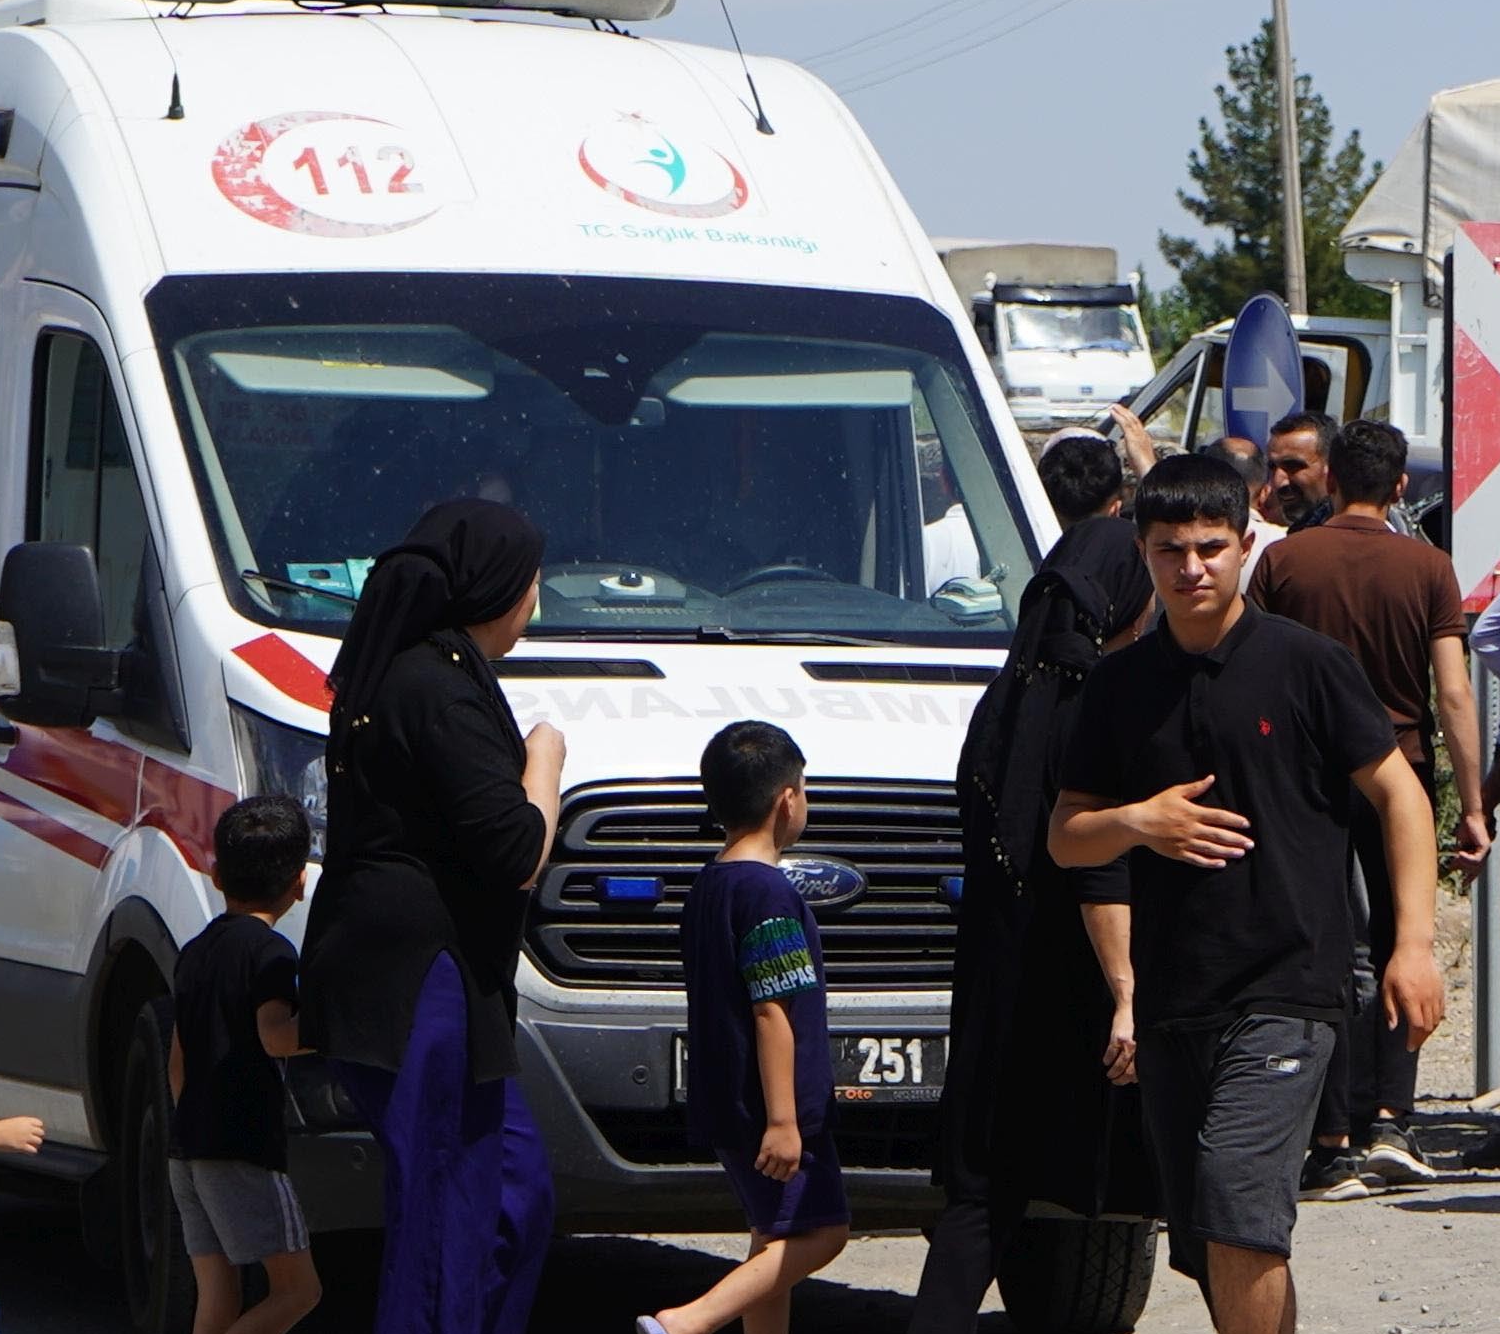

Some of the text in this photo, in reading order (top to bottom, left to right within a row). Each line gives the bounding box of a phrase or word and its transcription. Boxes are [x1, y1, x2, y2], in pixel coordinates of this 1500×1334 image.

[293, 146, 425, 195] 112
[785, 867, 839, 896] Ford
[857, 1037, 923, 1083] 251
[845, 1088, 873, 1100] Oto
